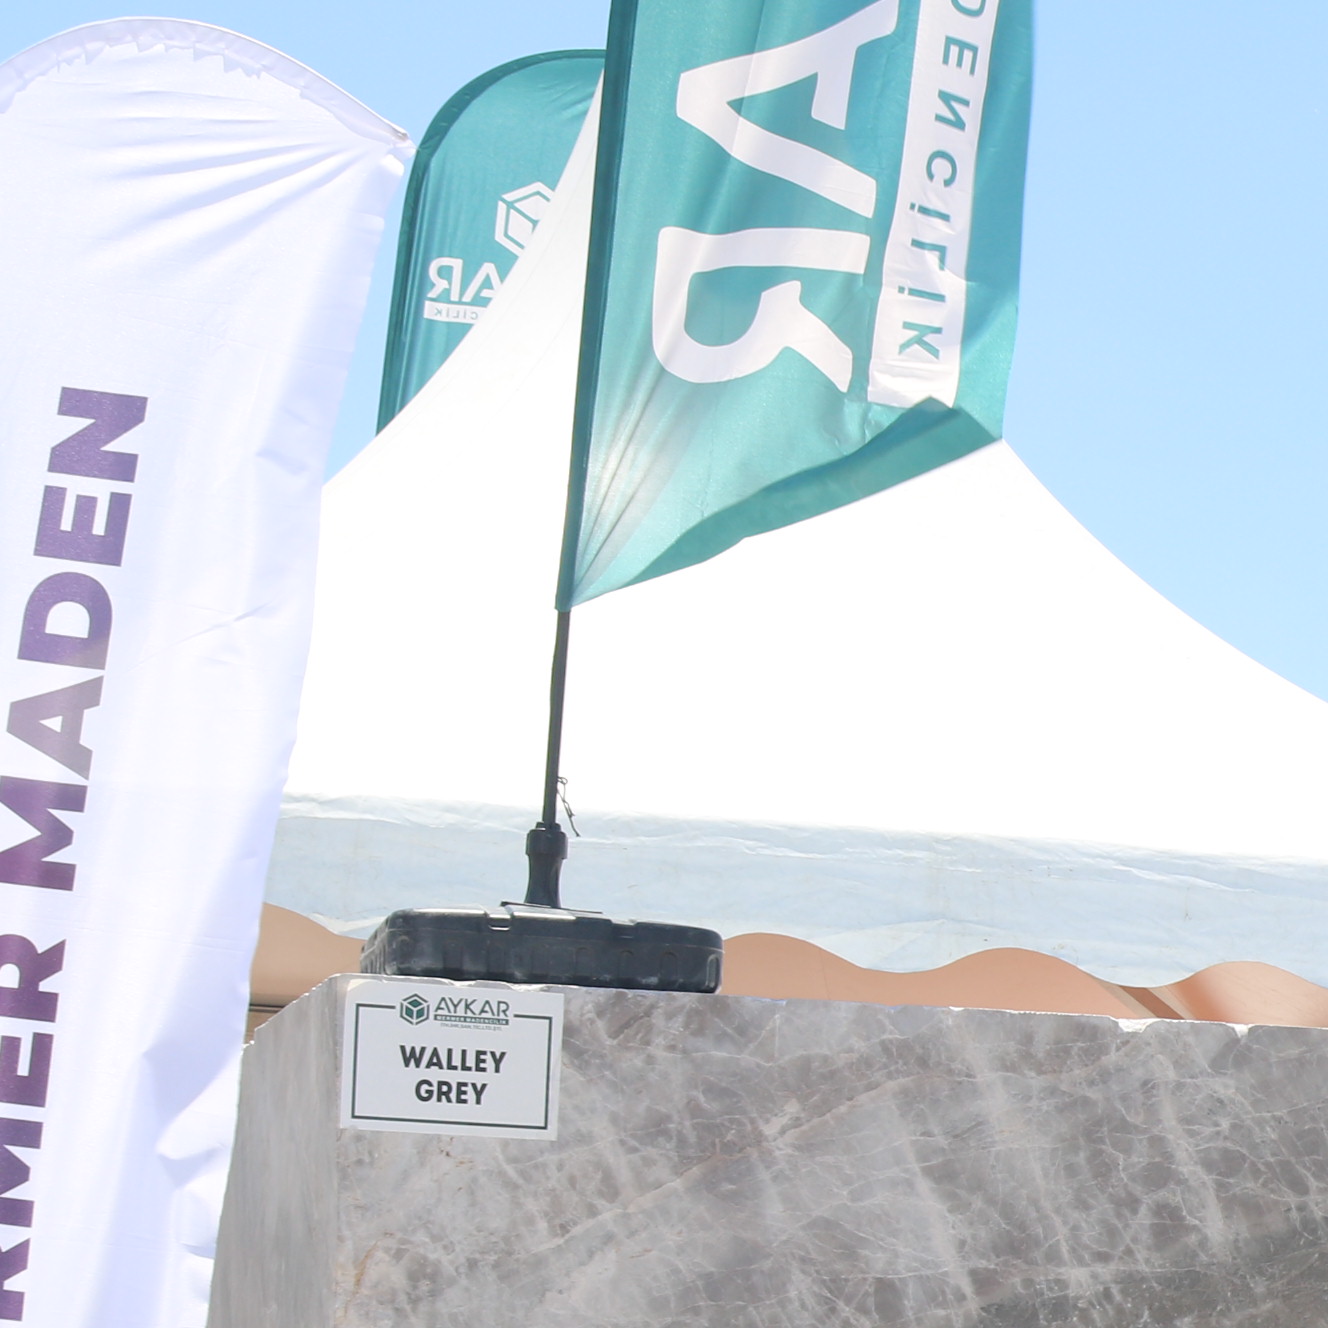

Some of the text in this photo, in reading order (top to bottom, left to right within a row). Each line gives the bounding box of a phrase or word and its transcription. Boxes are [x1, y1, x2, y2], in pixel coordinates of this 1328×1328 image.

[0, 386, 149, 891] MADEN
[434, 996, 510, 1018] AYKAR
[399, 1044, 507, 1074] WALLEY
[415, 1079, 488, 1105] GREY
